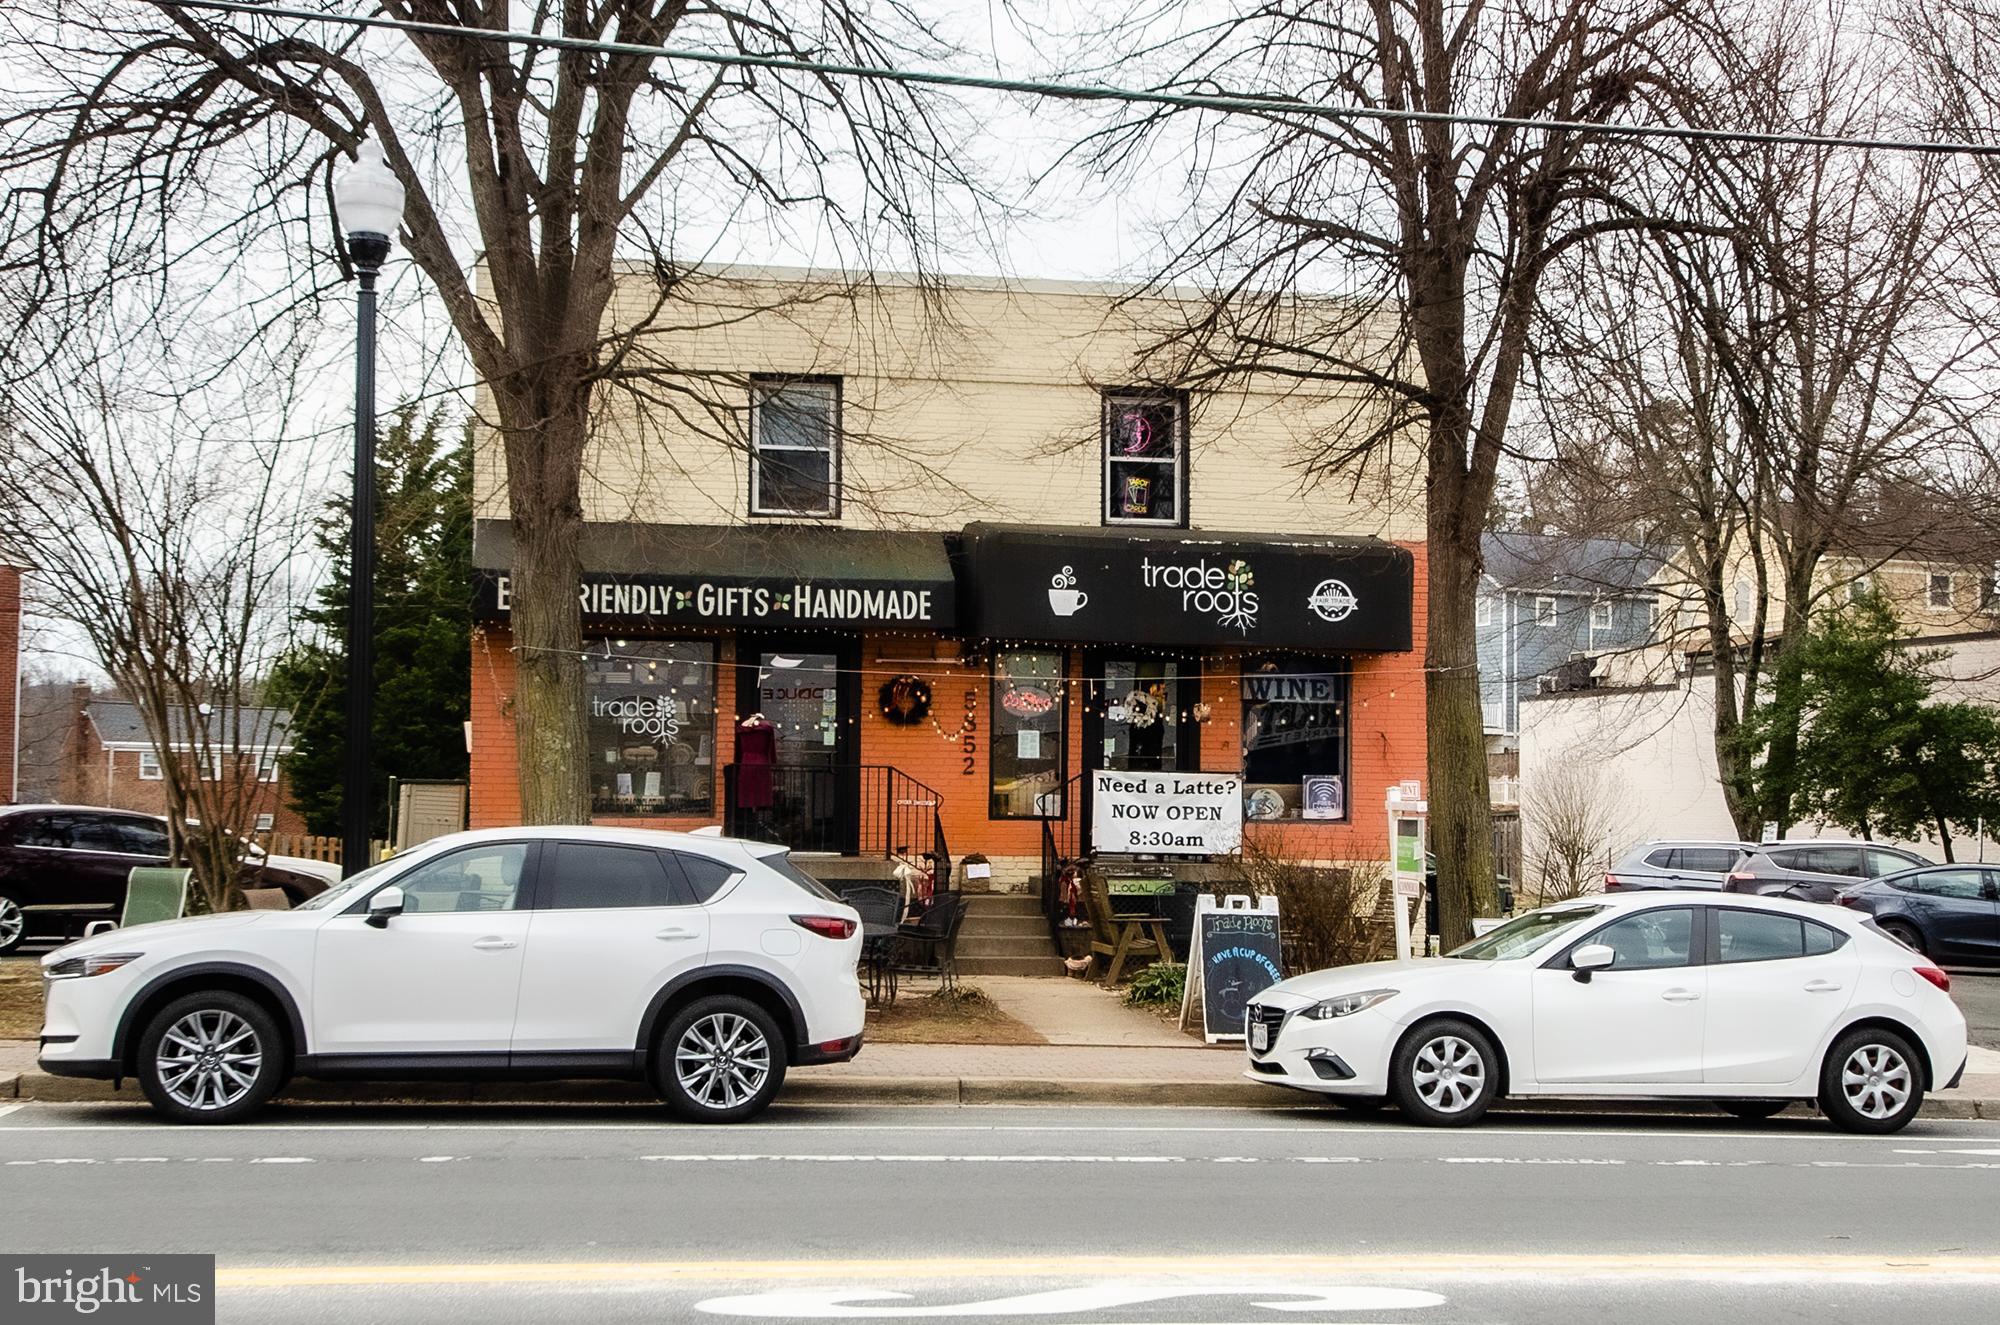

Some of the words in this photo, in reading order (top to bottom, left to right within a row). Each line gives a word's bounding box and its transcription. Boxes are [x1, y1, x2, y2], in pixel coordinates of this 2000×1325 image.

[1141, 557, 1226, 589] trade
[578, 583, 673, 615] RIENDLY
[697, 583, 770, 616] GIFTS
[794, 584, 932, 620] HANDMADE
[1183, 576, 1259, 616] roots
[1246, 677, 1331, 701] WINE
[592, 695, 656, 717] trade
[622, 707, 680, 735] roots
[1098, 777, 1147, 794] Need
[1155, 784, 1166, 794] a
[1173, 779, 1237, 795] Latte?
[1111, 804, 1160, 820] NOW
[1166, 806, 1223, 821] OPEN
[1129, 831, 1205, 847] 8:30am
[1113, 883, 1153, 893] LOCAL
[1206, 915, 1242, 931] Trade
[1243, 915, 1274, 932] Roots
[1211, 949, 1233, 964] HAVE
[1232, 946, 1240, 958] A
[1239, 947, 1256, 959] CUP
[1255, 953, 1268, 964] OF
